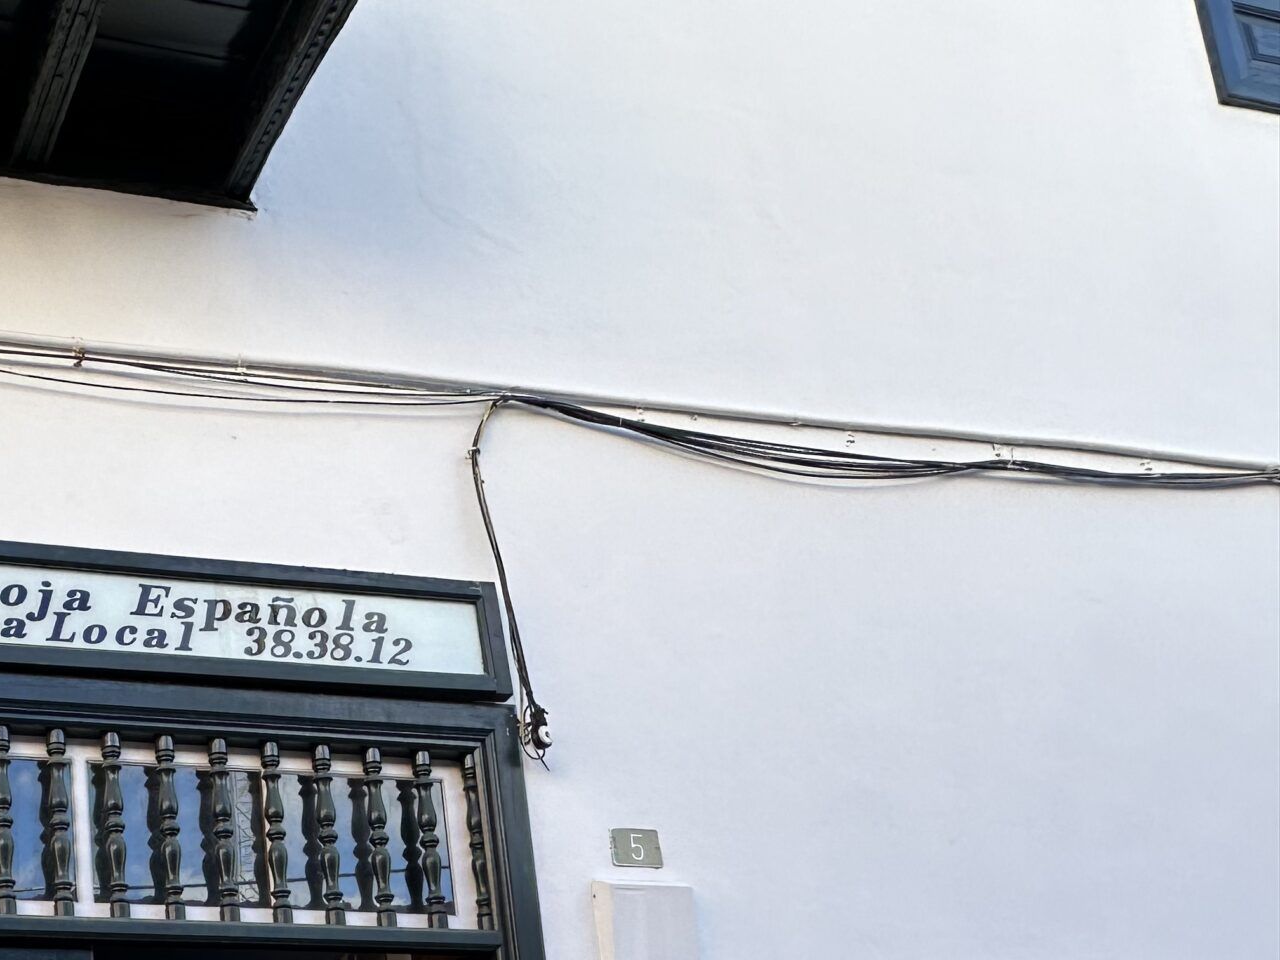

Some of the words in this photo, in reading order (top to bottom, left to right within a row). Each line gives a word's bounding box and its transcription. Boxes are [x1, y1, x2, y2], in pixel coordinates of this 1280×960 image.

[129, 583, 389, 633] Española
[45, 611, 194, 652] Local
[243, 625, 414, 666] 38.38.12
[630, 833, 644, 861] 5
